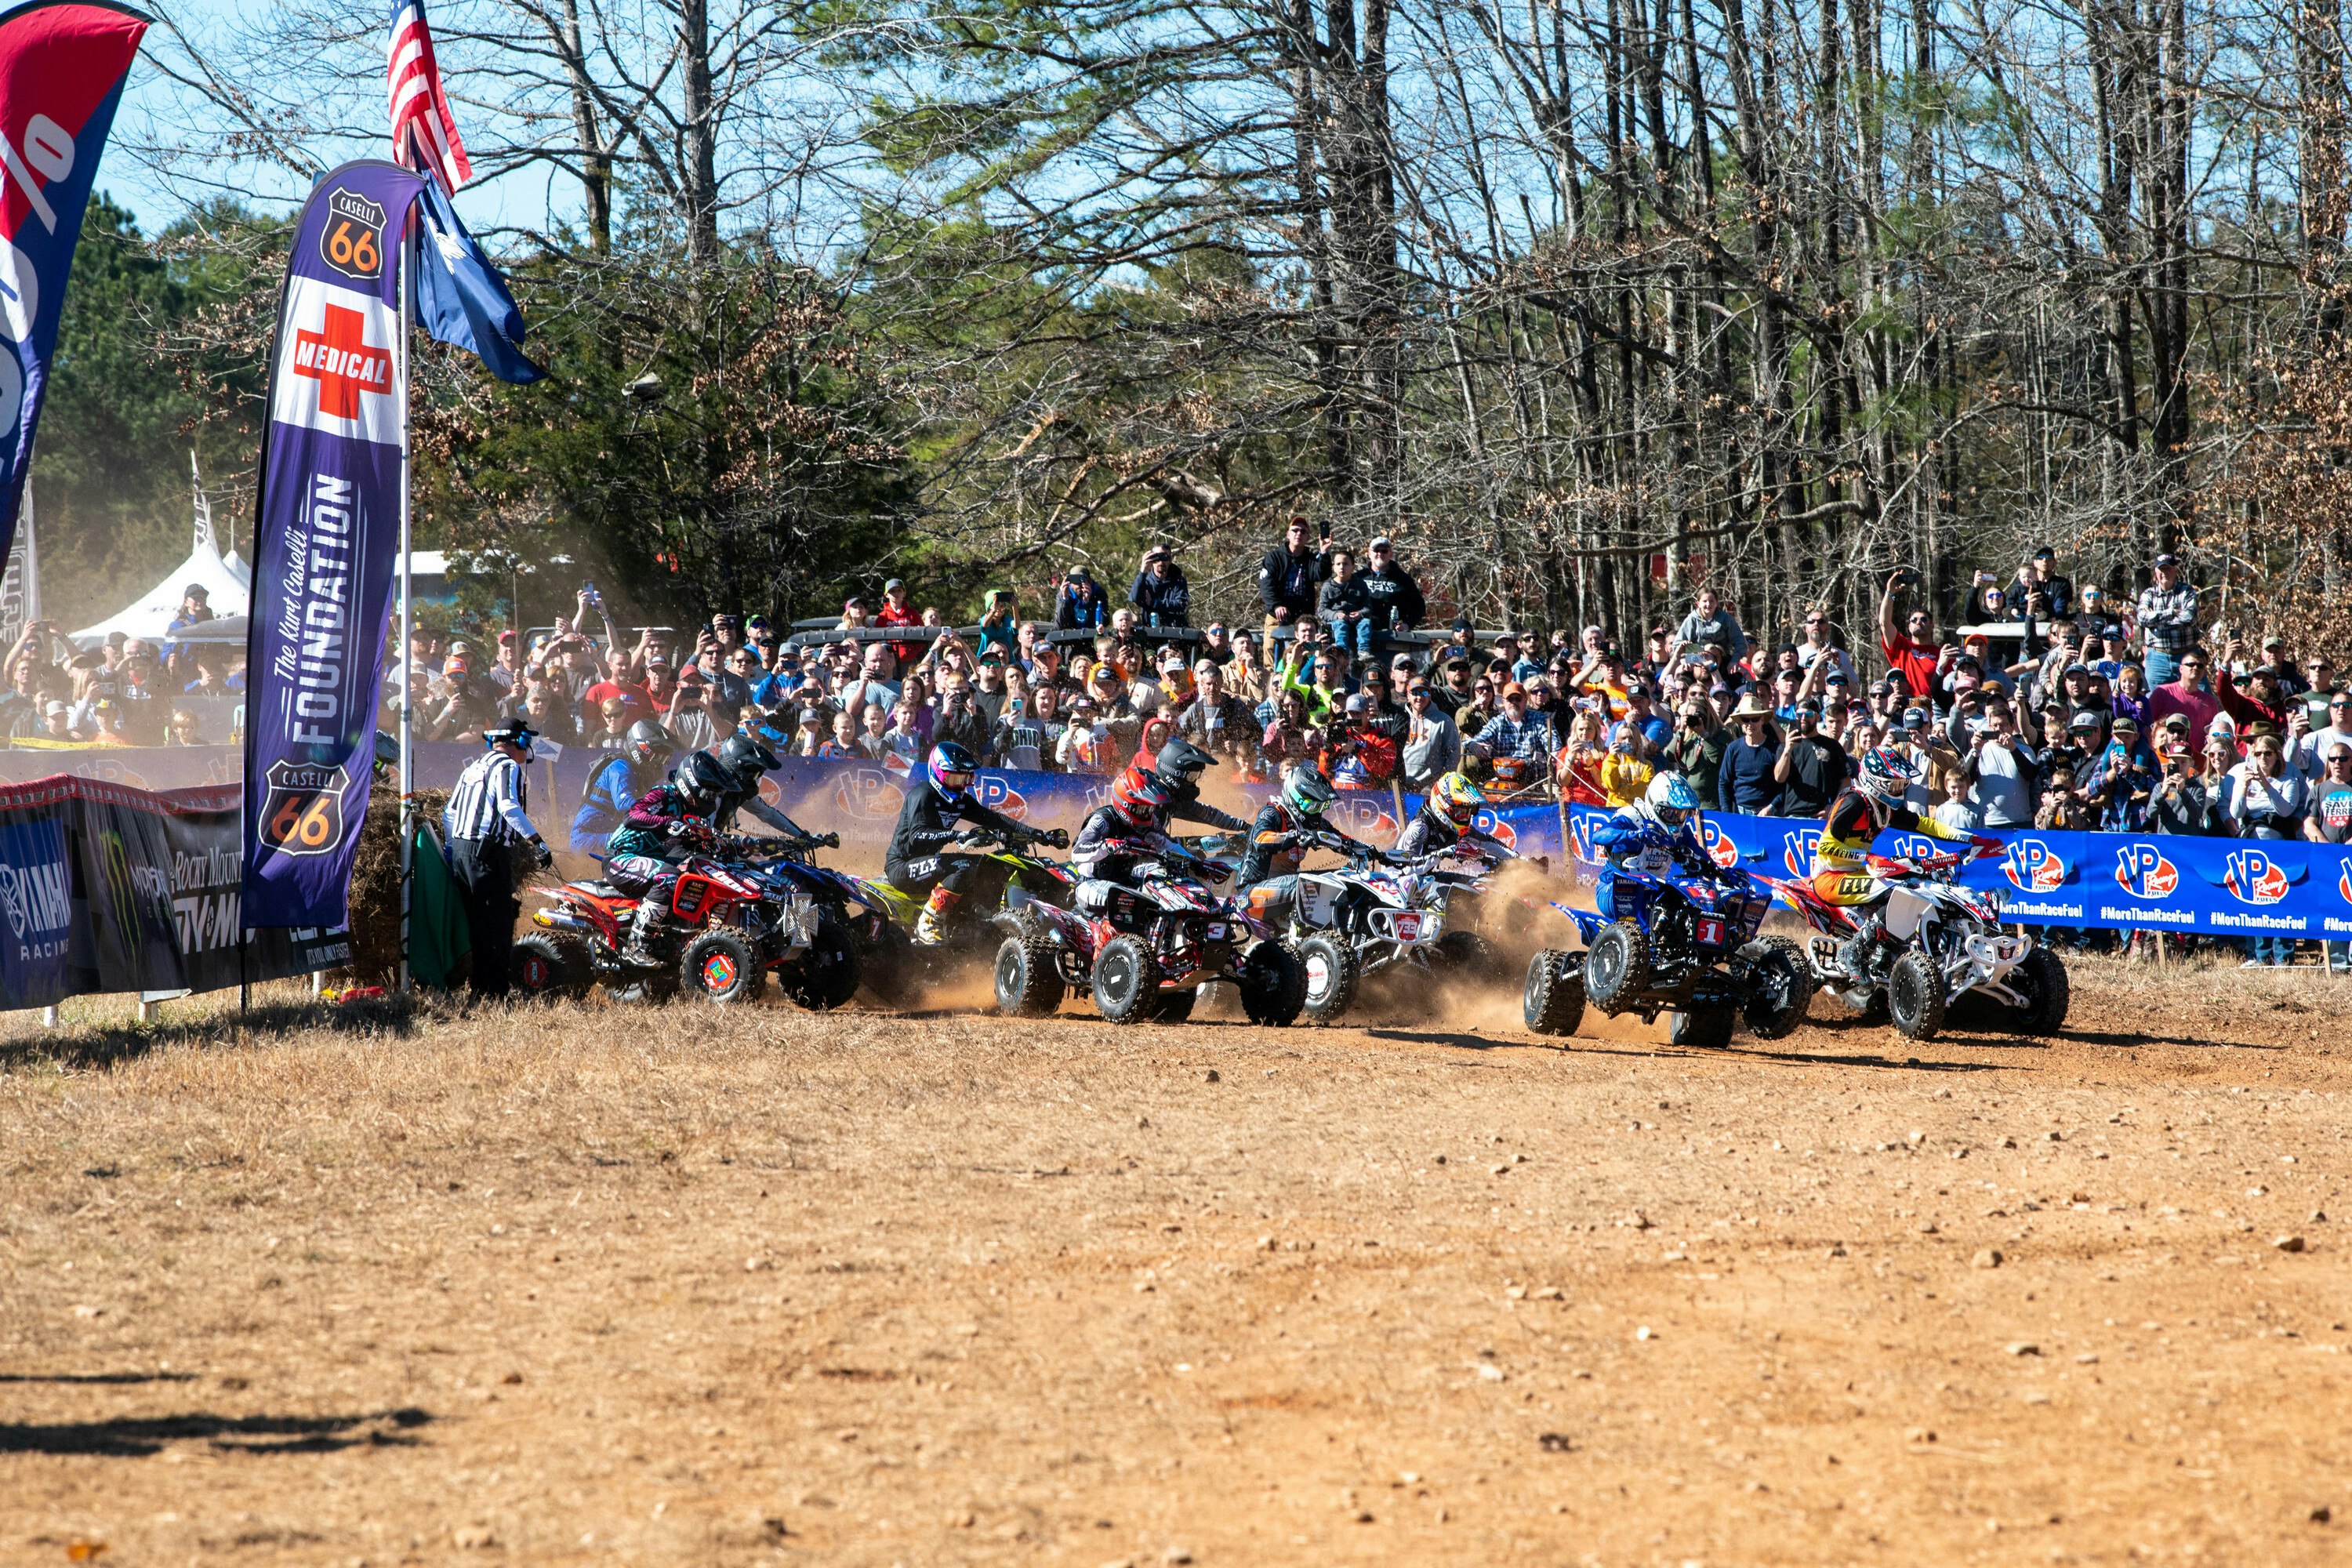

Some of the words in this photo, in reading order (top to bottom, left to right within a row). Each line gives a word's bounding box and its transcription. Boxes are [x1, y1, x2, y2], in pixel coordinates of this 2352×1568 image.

[339, 197, 376, 222] CASELLI
[330, 221, 377, 271] 66
[296, 340, 386, 383] MEDICAL
[283, 525, 307, 597] Caselli
[278, 596, 302, 644] Kurt
[292, 474, 352, 745] FOUNDATION
[274, 644, 297, 682] The
[282, 771, 335, 788] CASELLI
[271, 797, 331, 846] 66
[1828, 848, 1860, 860] RACING
[1925, 857, 1957, 866] RENTHAL
[2007, 839, 2049, 892] VP
[176, 851, 208, 892] ROCKY
[909, 858, 938, 879] FLY
[2117, 844, 2161, 898] VP
[2227, 849, 2270, 903] VP
[1843, 878, 1871, 892] FLY
[2000, 901, 2083, 917] oreThanRaceFuel
[2100, 906, 2194, 924] #MoreThanRaceFuel
[2210, 912, 2307, 930] #MoreThanRaceFuel
[1207, 922, 1228, 939] 3
[1397, 920, 1417, 935] 733
[1703, 923, 1717, 942] 1
